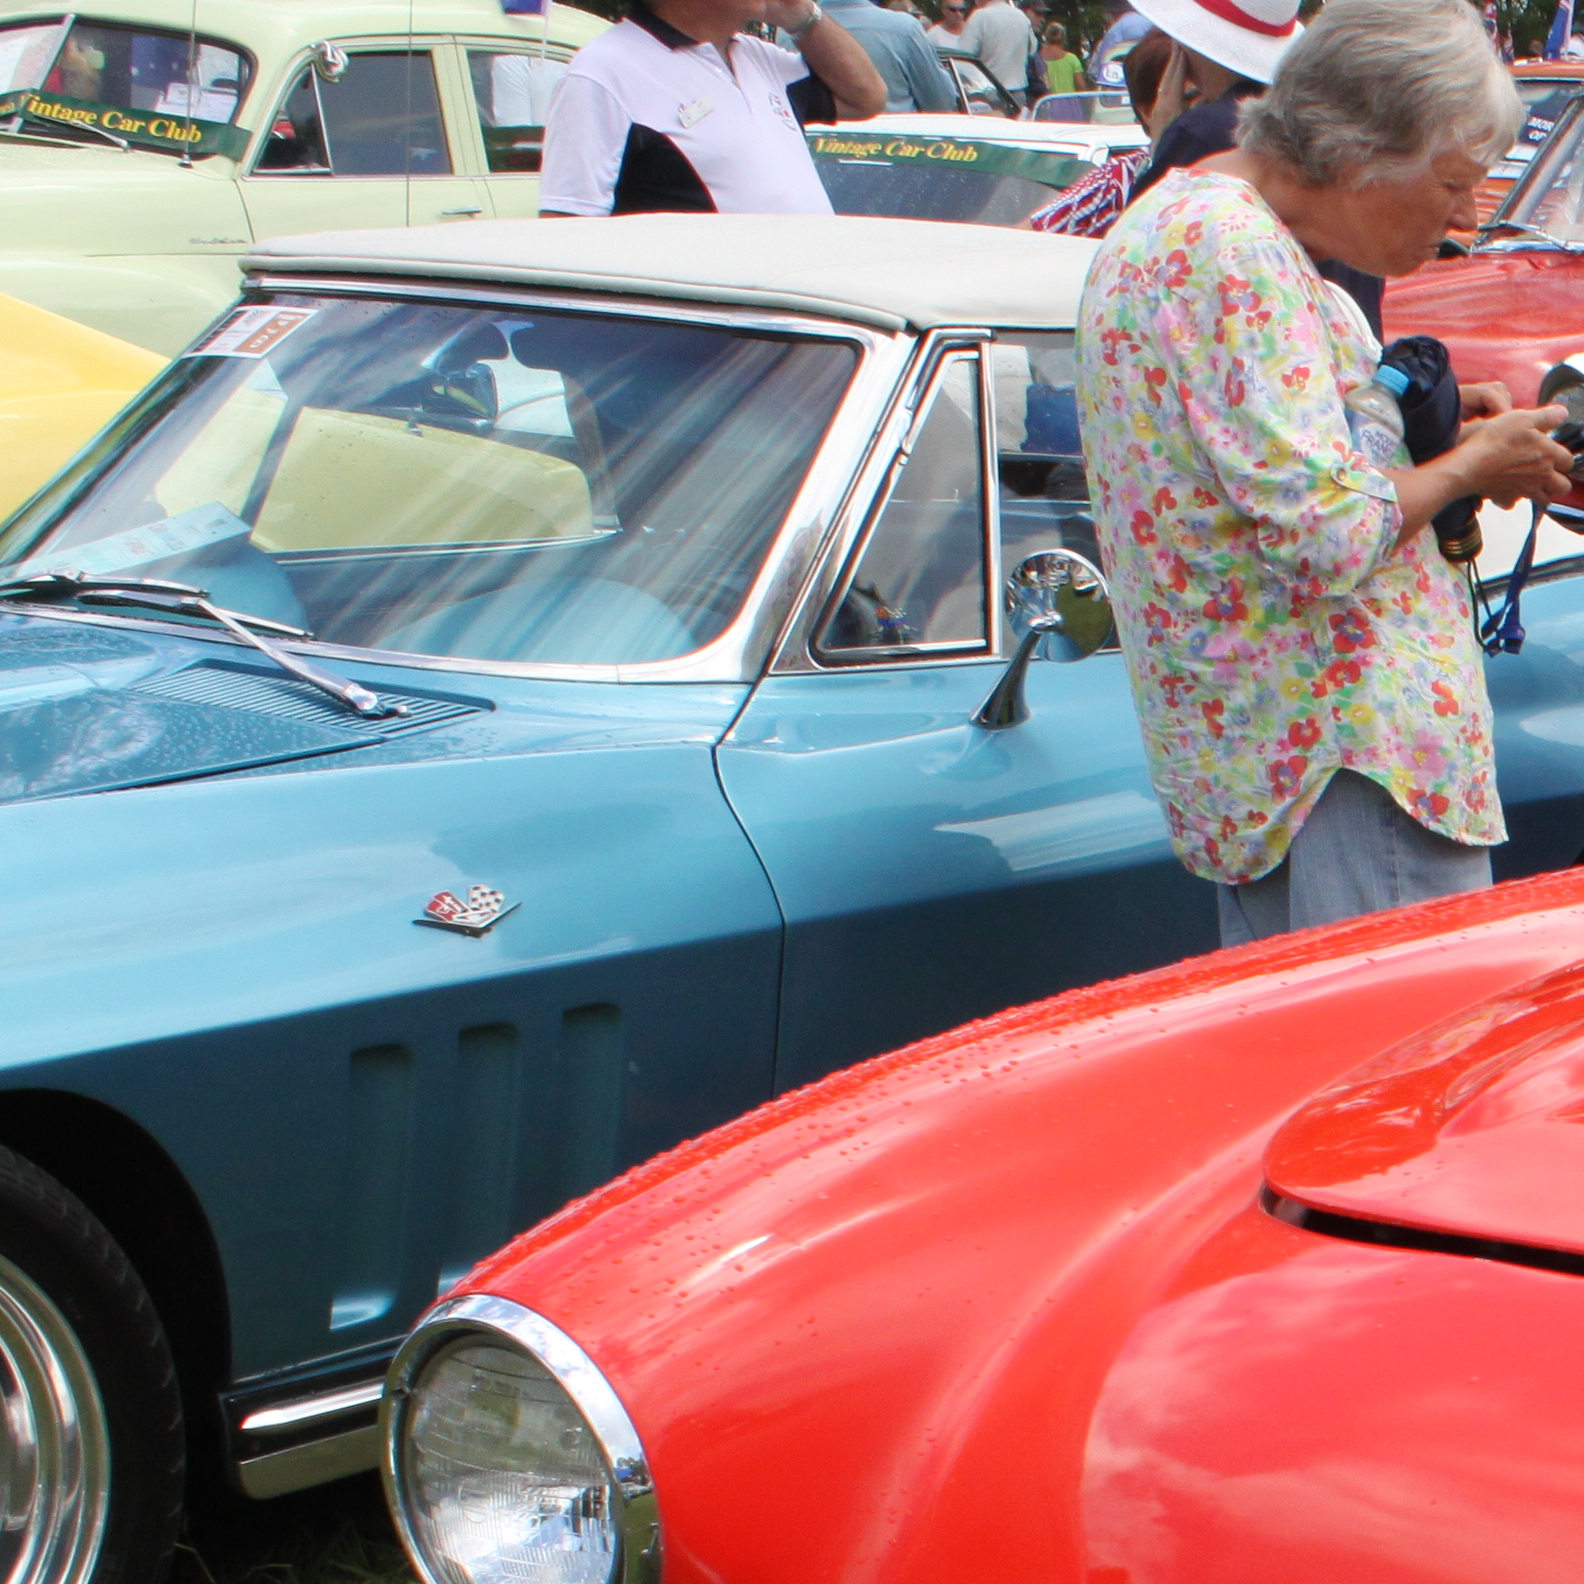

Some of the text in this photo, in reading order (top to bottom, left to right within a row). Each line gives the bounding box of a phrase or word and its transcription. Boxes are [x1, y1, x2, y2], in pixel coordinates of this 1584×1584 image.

[20, 94, 97, 124] Vintage
[102, 110, 146, 134] Car
[148, 118, 203, 144] Club
[815, 137, 979, 163] Vintage Car Club
